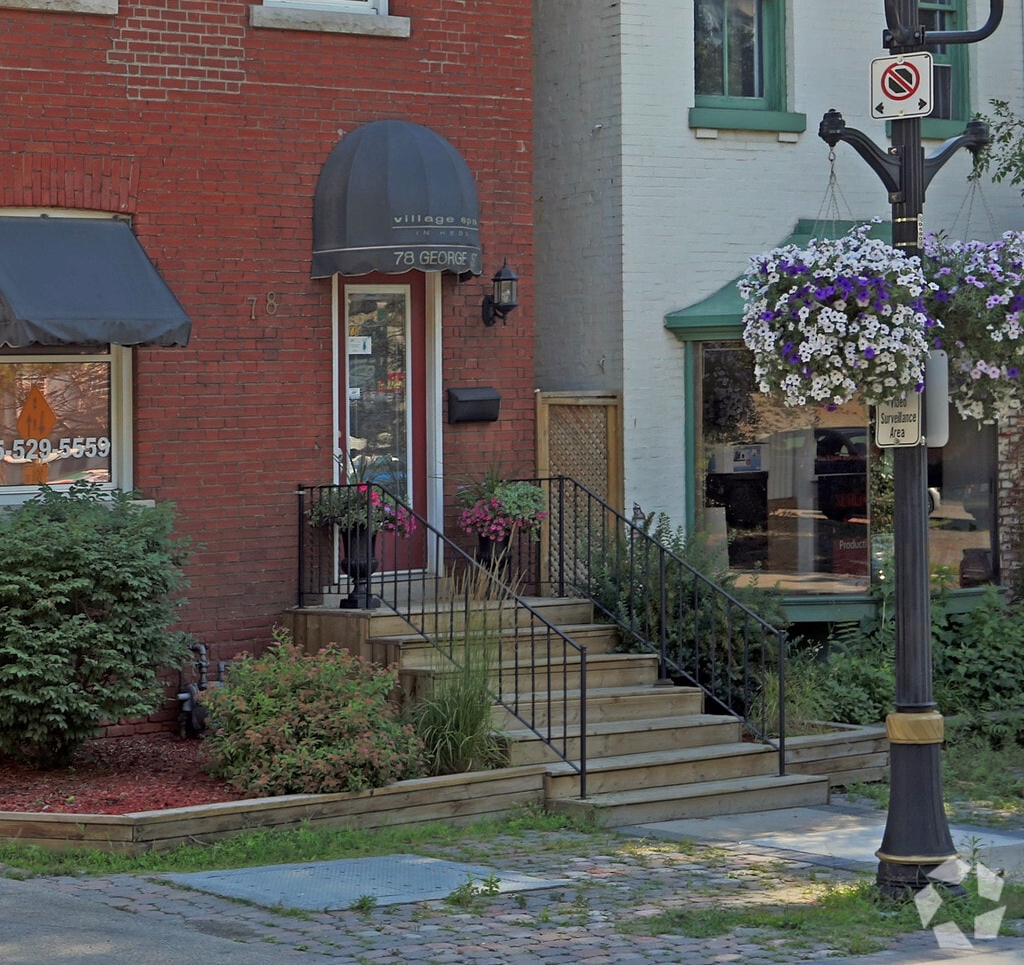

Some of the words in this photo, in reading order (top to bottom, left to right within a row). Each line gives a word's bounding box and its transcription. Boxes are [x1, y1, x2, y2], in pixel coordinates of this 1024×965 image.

[394, 215, 454, 225] village
[394, 251, 415, 265] 78
[419, 251, 468, 265] GEORGE
[247, 291, 276, 319] 78
[880, 412, 916, 424] Surveillance
[890, 426, 905, 438] Area
